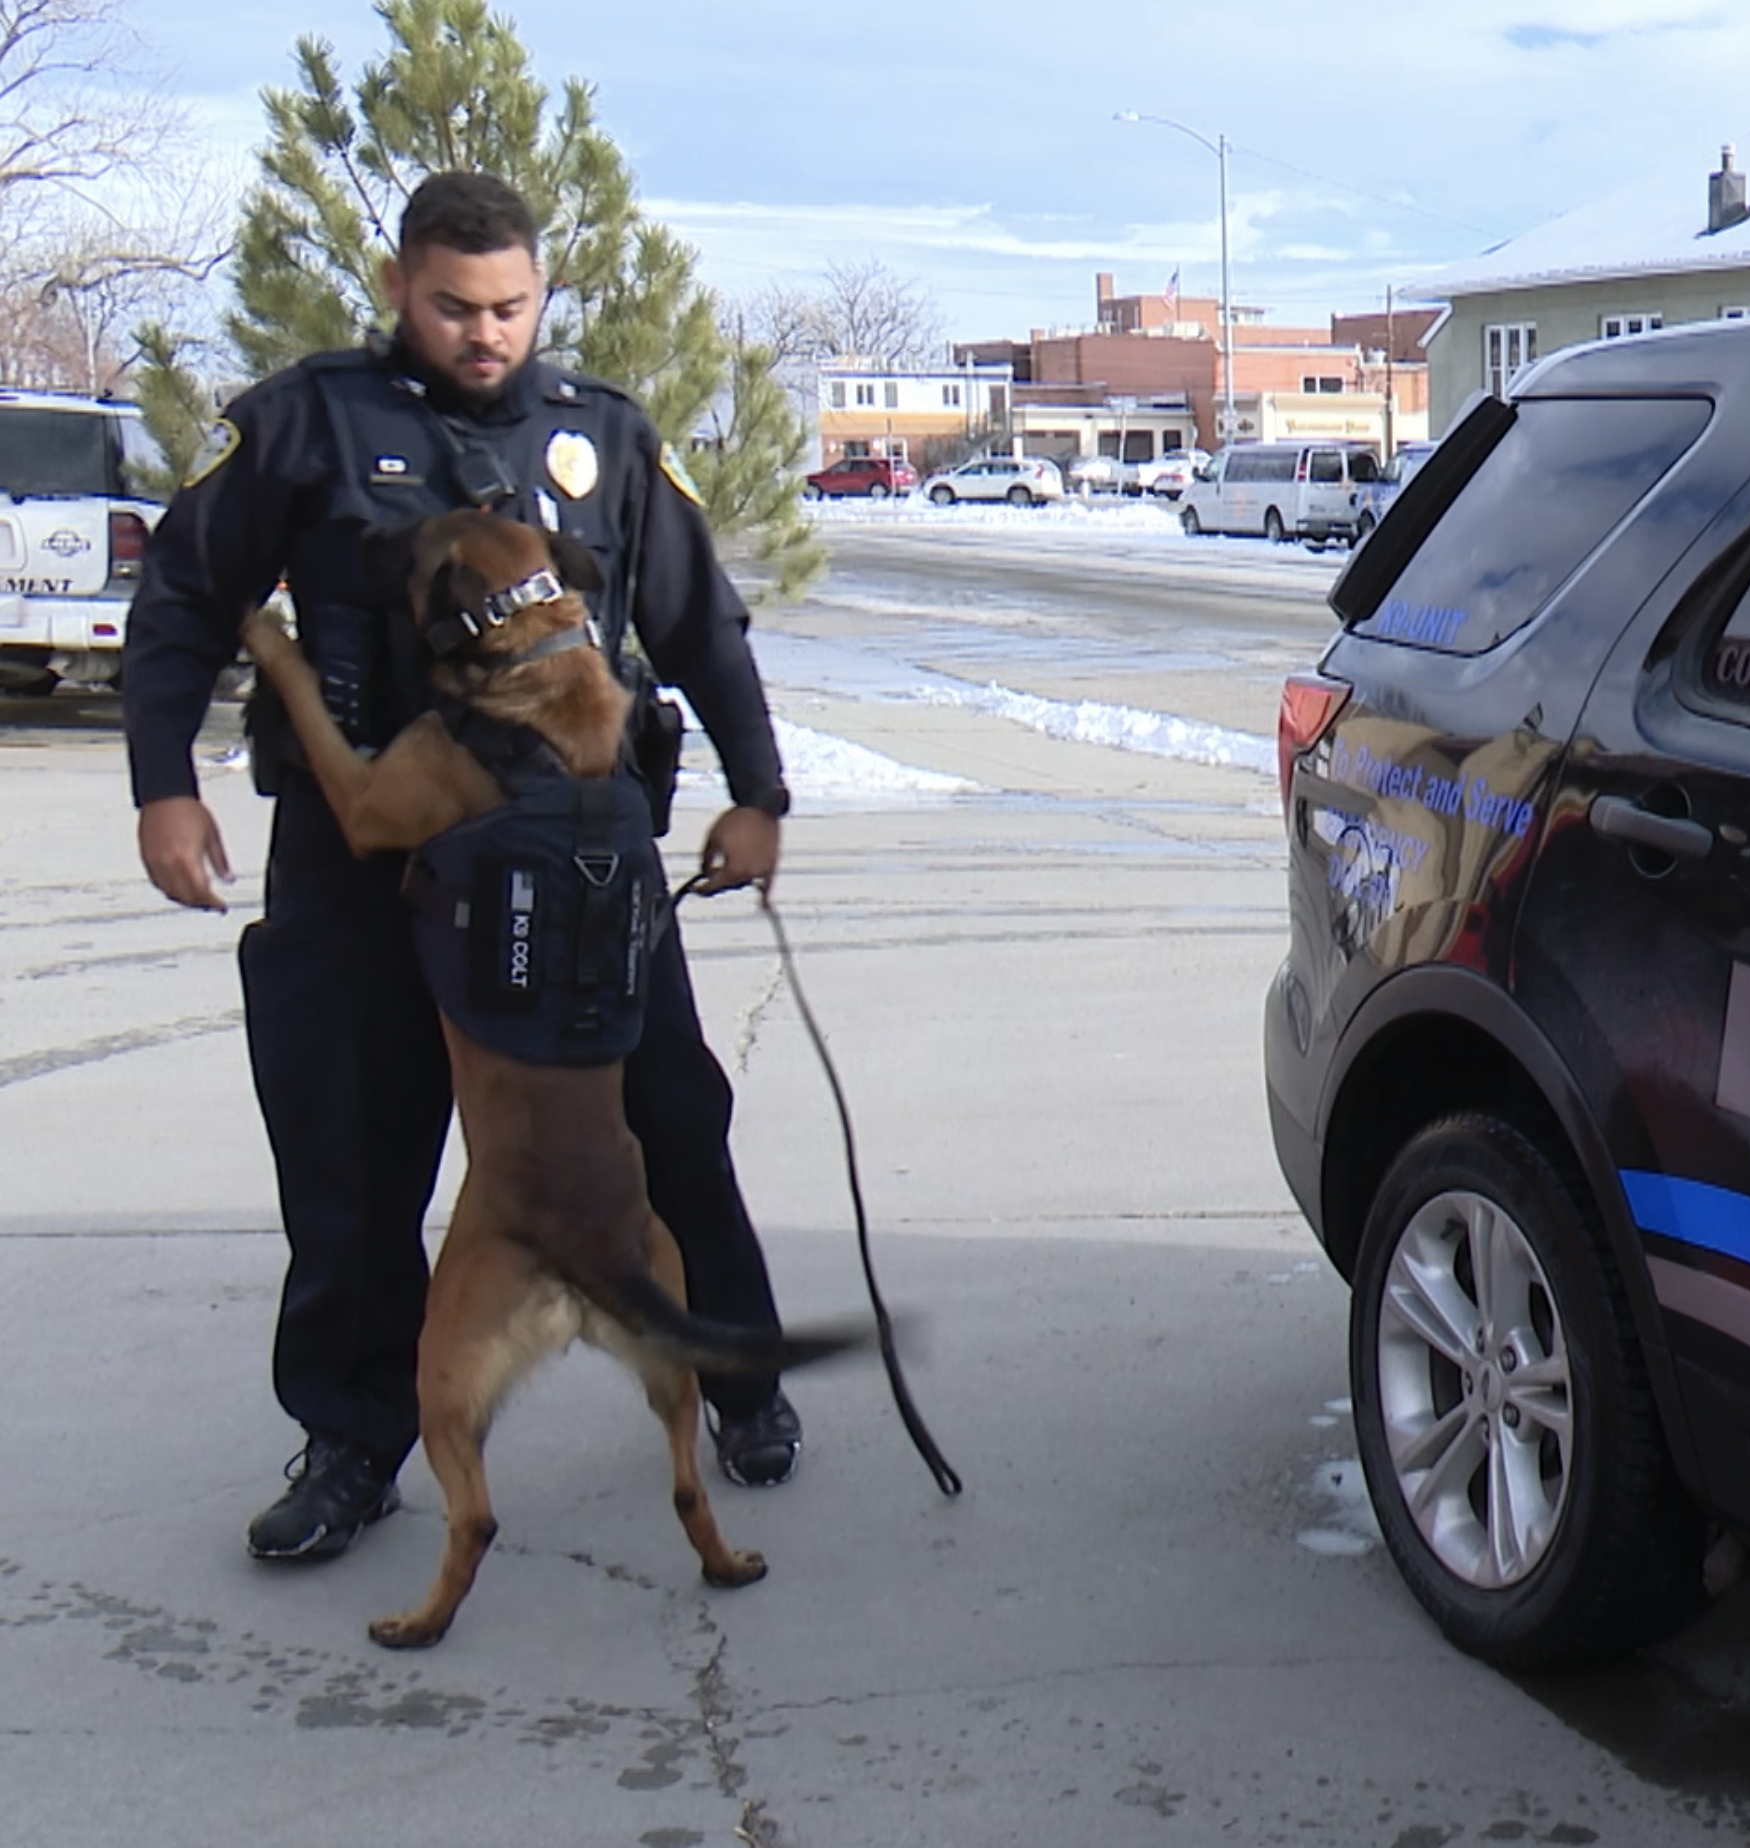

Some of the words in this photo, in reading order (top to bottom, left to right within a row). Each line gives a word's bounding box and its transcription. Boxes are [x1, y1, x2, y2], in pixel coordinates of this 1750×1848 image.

[1354, 745, 1423, 800] Protect
[1423, 772, 1467, 816] and
[1464, 775, 1534, 837] Serve
[511, 914, 530, 938] K9
[510, 941, 529, 988] COLT
